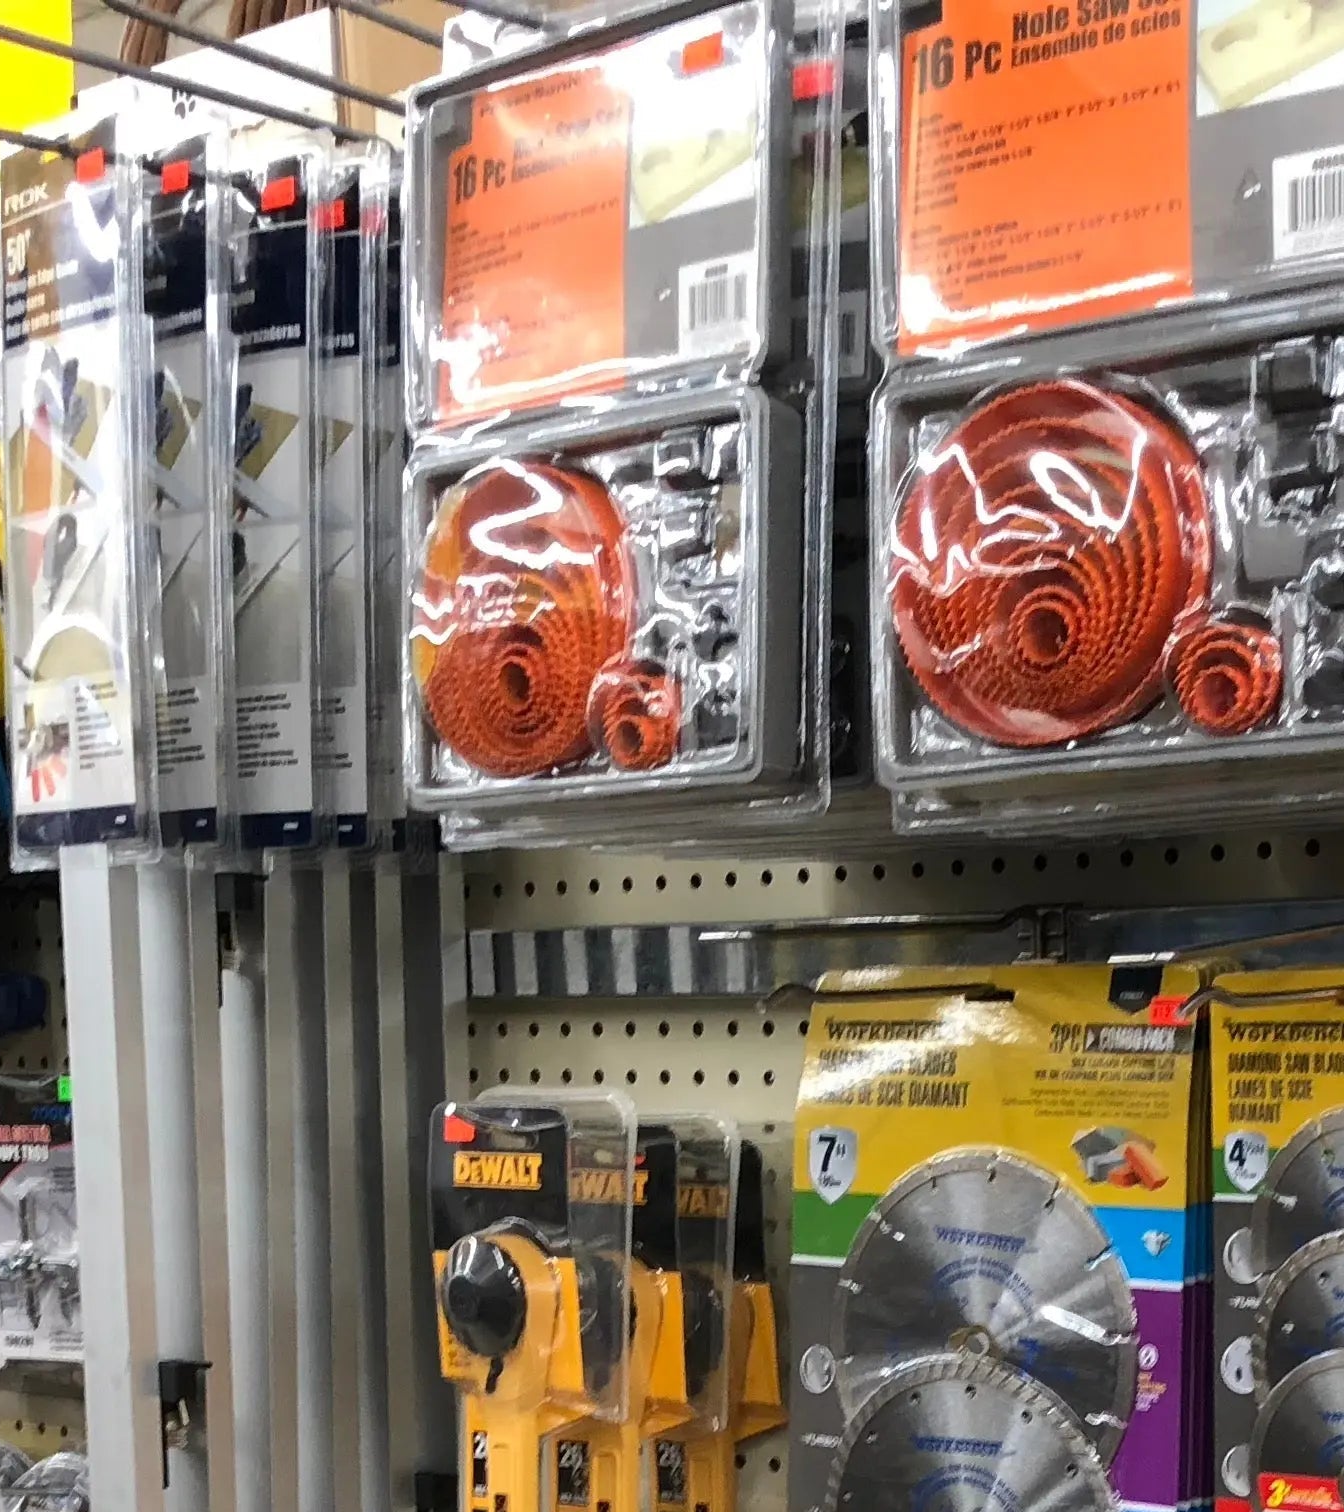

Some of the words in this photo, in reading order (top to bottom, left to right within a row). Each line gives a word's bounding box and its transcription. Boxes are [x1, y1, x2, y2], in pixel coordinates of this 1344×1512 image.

[1011, 29, 1099, 69] Ensemble
[1103, 22, 1126, 46] de
[1130, 9, 1182, 39] scies
[1013, 4, 1069, 43] Hole
[914, 36, 954, 95] 16
[5, 182, 50, 216] ROK
[453, 154, 478, 205] 16
[908, 1080, 971, 1108] DIAMANT
[1228, 1078, 1267, 1101] LAMES
